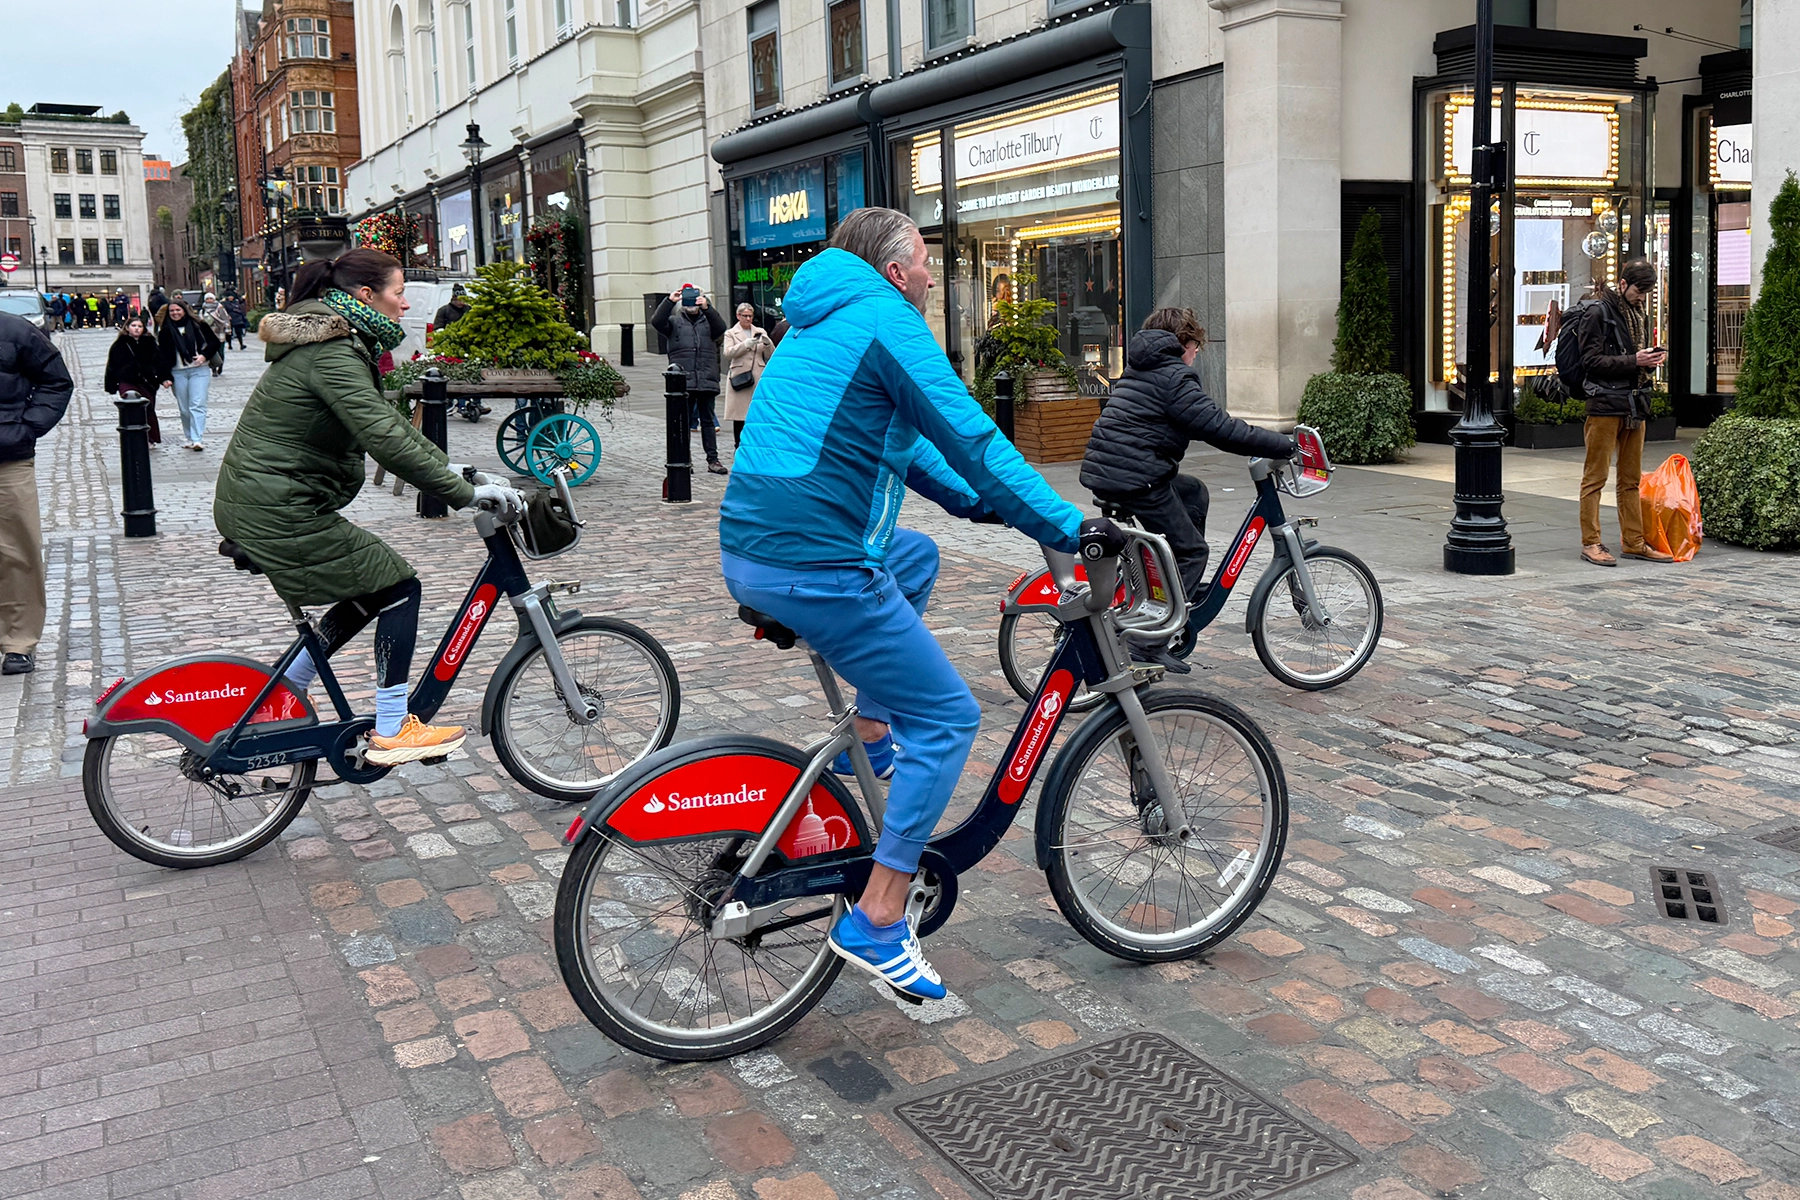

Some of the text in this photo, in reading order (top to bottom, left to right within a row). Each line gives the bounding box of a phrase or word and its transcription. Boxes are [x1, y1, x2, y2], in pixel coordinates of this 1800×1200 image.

[997, 190, 1020, 206] COVENT
[1020, 186, 1046, 202] GARDEN
[1046, 181, 1071, 198] BEAUTY
[769, 189, 809, 226] HOKA
[319, 229, 344, 238] HEAD
[737, 269, 757, 283] SHARE
[757, 267, 769, 281] THE
[451, 621, 473, 654] Santander
[164, 683, 247, 704] Santander
[1018, 720, 1045, 766] Santander
[247, 753, 287, 770] 52342
[667, 783, 767, 812] Santander
